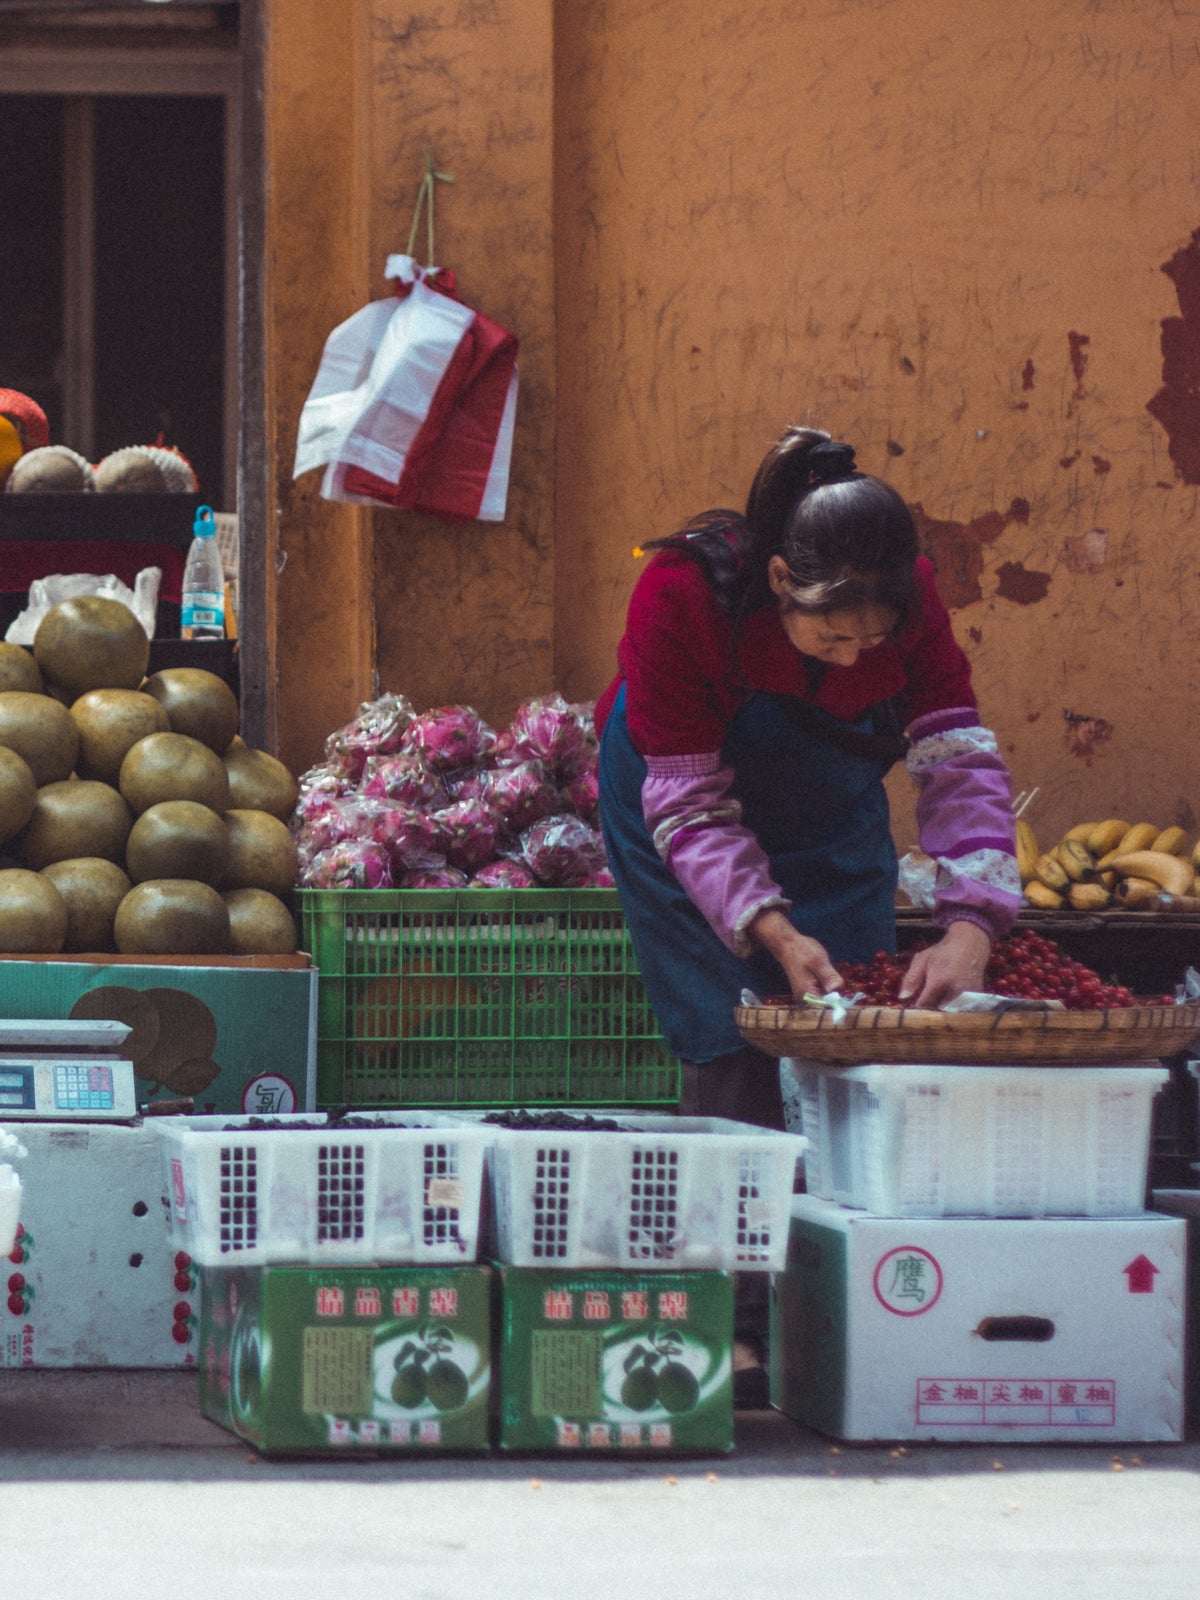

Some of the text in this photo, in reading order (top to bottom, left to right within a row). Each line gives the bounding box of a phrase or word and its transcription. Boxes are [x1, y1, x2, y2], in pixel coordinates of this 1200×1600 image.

[888, 1255, 927, 1303] 鹰
[316, 1286, 458, 1316] 精品香梨
[544, 1290, 688, 1320] 精品香梨
